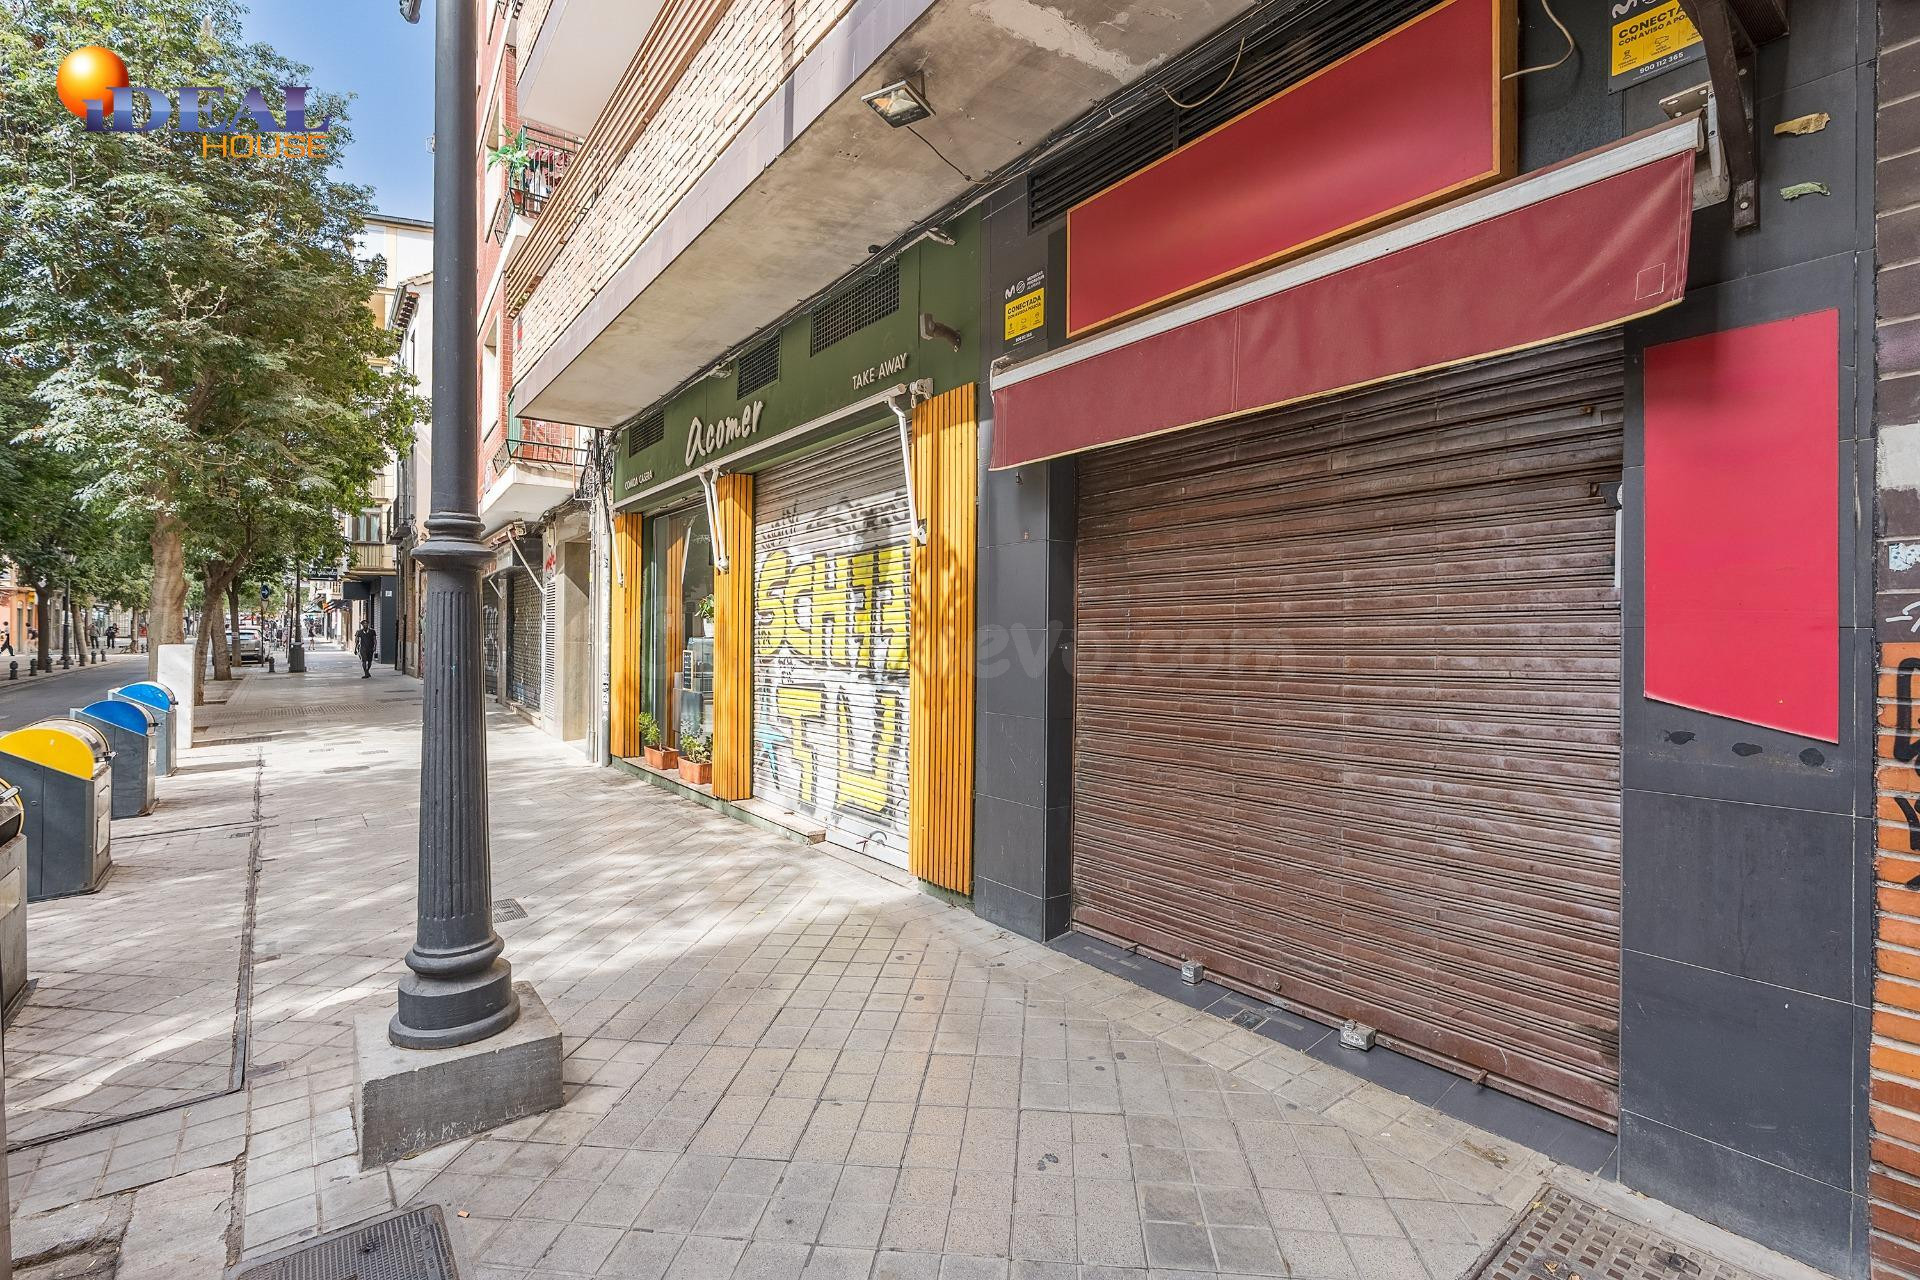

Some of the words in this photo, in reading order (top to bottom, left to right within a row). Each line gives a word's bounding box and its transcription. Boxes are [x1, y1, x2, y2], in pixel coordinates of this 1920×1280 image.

[1618, 34, 1637, 46] CON
[1638, 24, 1664, 38] AVISO
[1007, 295, 1042, 315] CONECTADA
[852, 367, 875, 390] TAKE
[878, 352, 908, 379] AWAY
